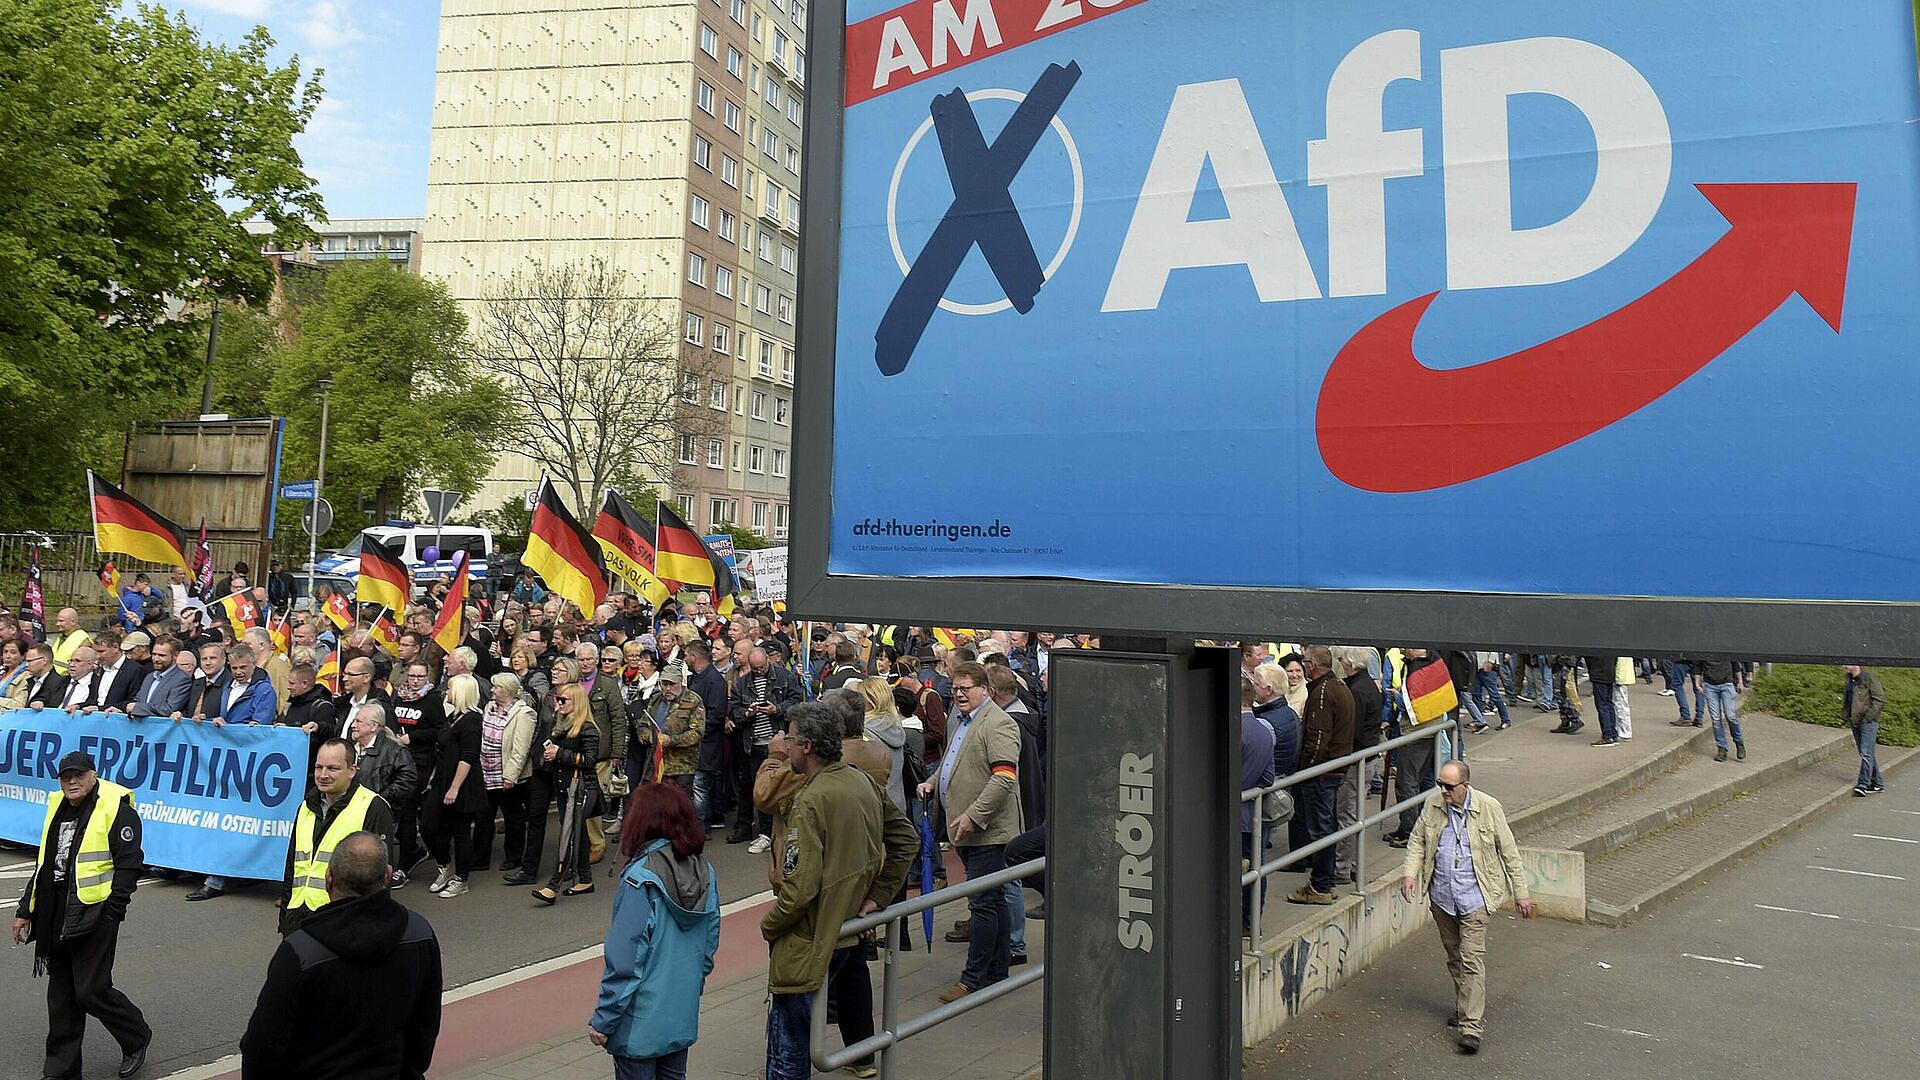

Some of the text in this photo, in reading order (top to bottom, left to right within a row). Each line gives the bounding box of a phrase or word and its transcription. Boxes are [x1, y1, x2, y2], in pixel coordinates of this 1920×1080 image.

[872, 0, 1003, 89] AM
[1100, 29, 1672, 313] AfD
[634, 545, 654, 565] SIN
[853, 518, 1011, 542] afd-thueringen.de
[605, 550, 651, 590] DAS VOLK
[80, 735, 292, 807] FRÜHLING
[139, 801, 200, 827] FRÜHLING
[200, 810, 219, 829] IM
[221, 814, 261, 836] OSTEN
[1115, 752, 1154, 954] STRÖER
